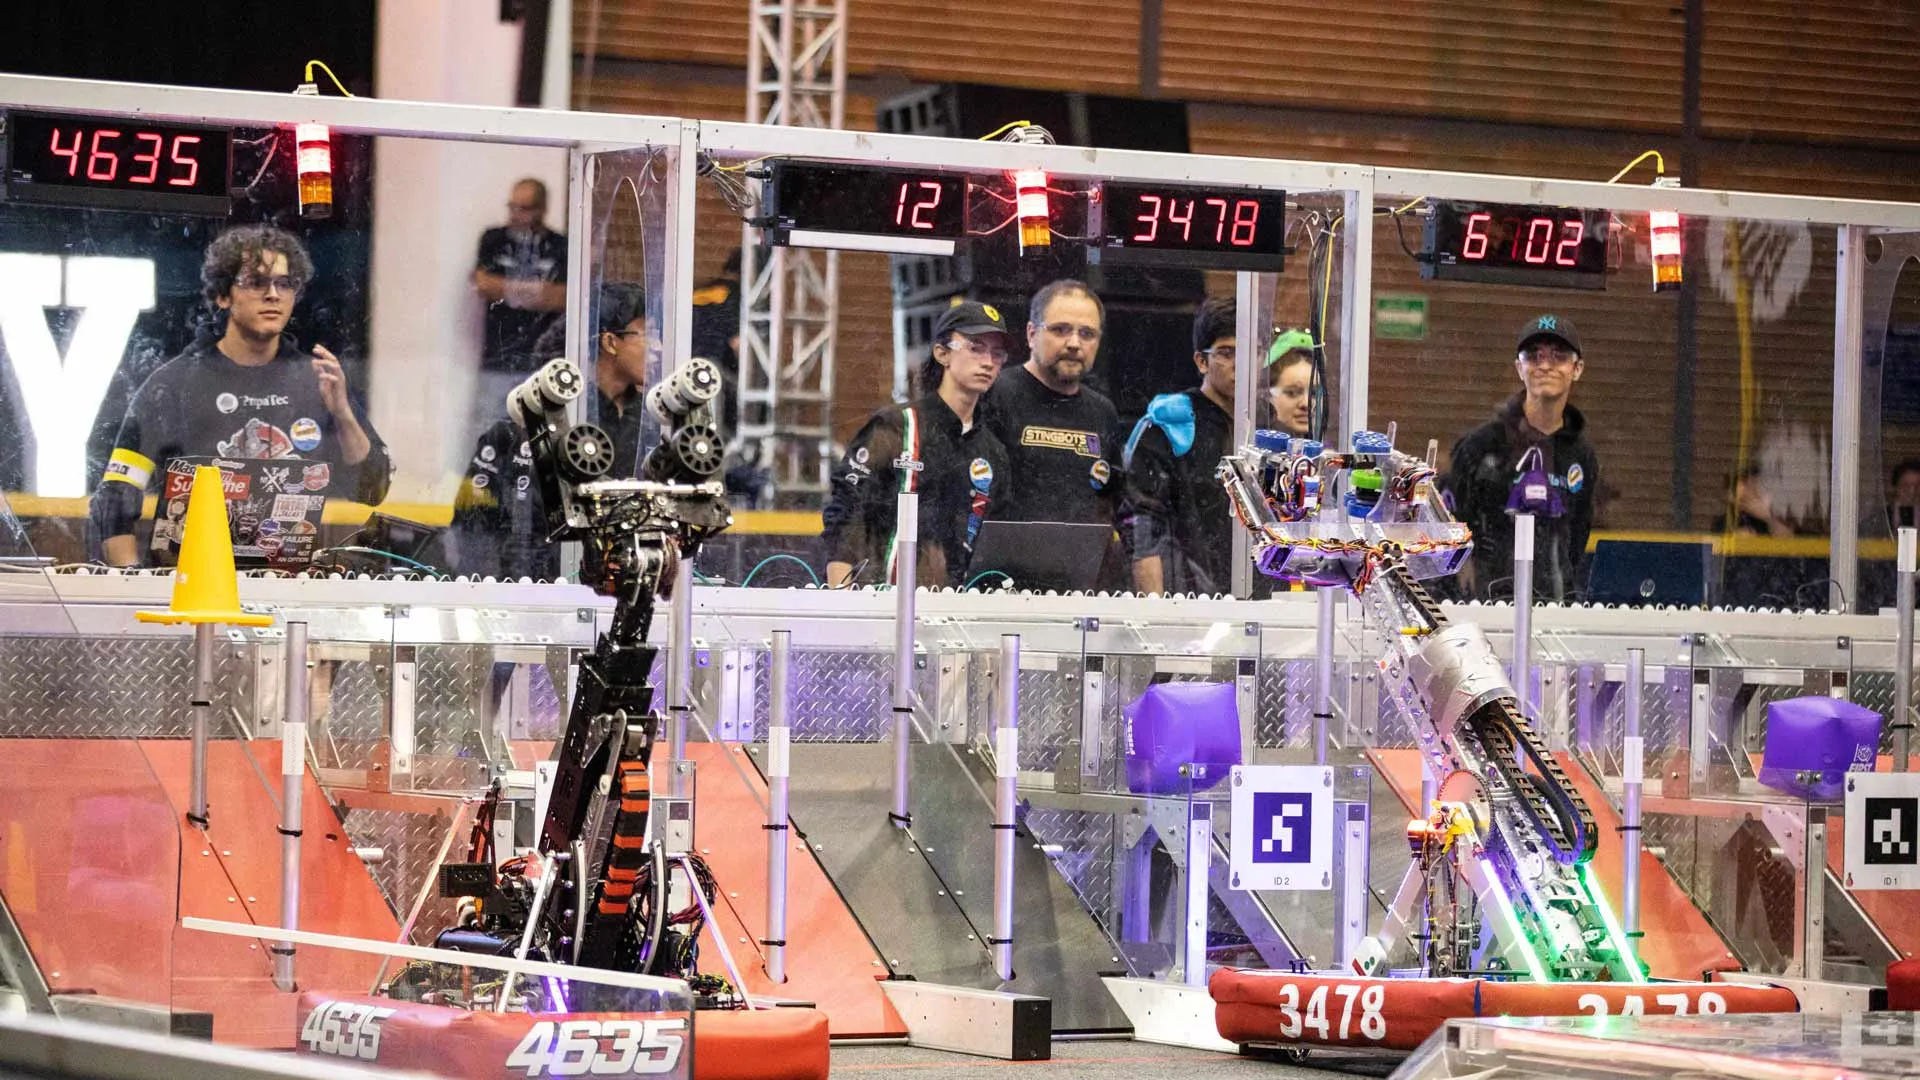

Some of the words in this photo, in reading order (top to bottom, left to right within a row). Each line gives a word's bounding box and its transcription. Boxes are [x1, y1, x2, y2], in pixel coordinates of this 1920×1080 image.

[50, 127, 201, 187] 4635
[895, 181, 942, 229] 12
[1133, 194, 1260, 246] 3478
[1026, 429, 1087, 446] STINGBOTS
[1273, 877, 1283, 886] ID
[1284, 877, 1290, 886] 2
[1883, 877, 1892, 886] ID
[301, 1000, 397, 1060] 4635
[1279, 983, 1387, 1040] 3478
[506, 1018, 690, 1077] 4635
